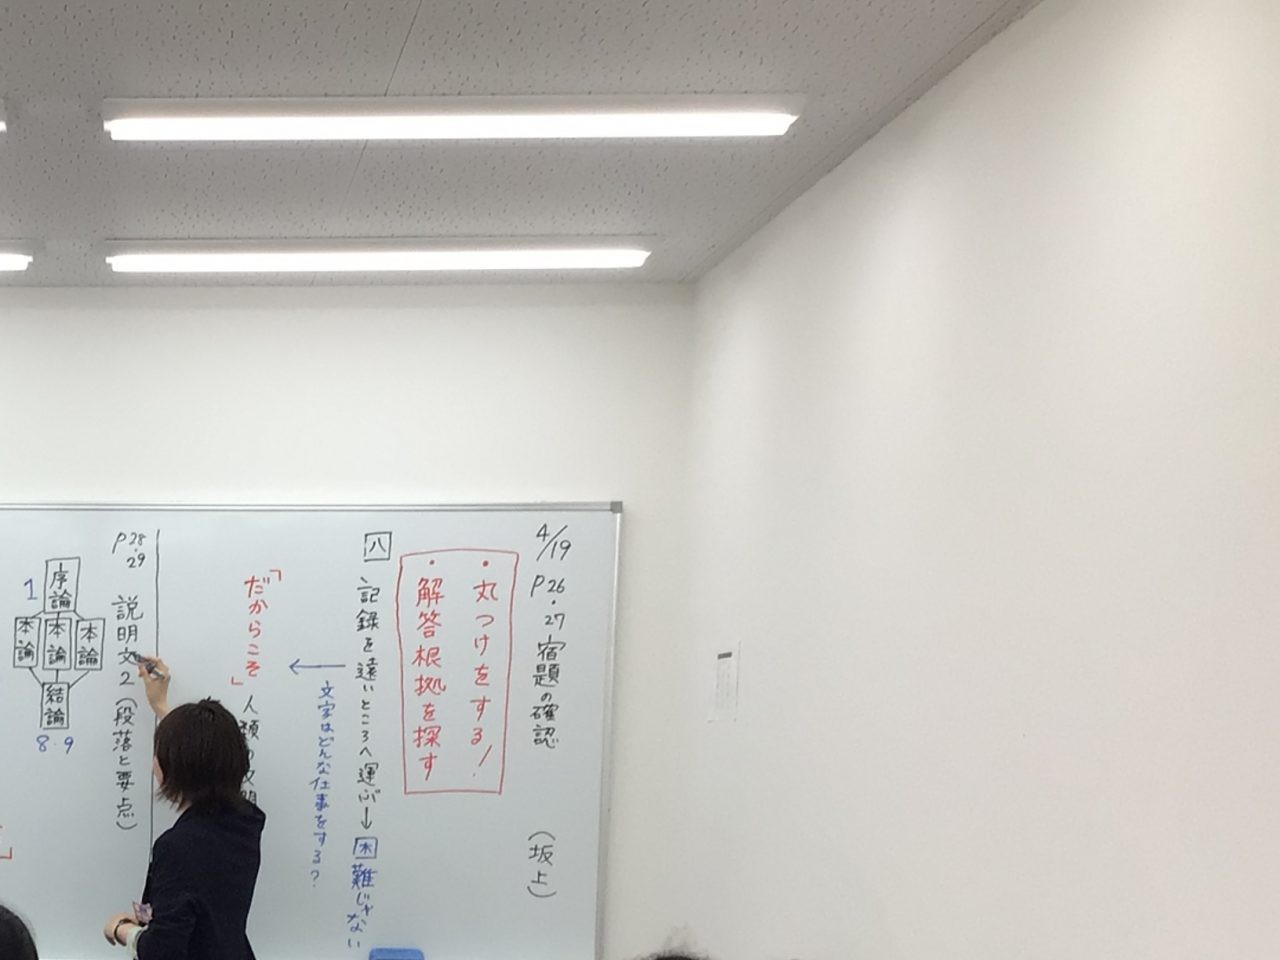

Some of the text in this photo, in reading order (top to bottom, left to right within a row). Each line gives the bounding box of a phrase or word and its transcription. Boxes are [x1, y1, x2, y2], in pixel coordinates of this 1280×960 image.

[535, 523, 571, 562] 4/19
[24, 577, 38, 601] 1
[48, 562, 72, 610] 序論
[16, 618, 35, 663] 本論
[46, 621, 67, 666] 本論
[77, 622, 100, 666] 本論
[412, 576, 447, 781] 解答根拠を探す
[44, 685, 66, 727] 結論
